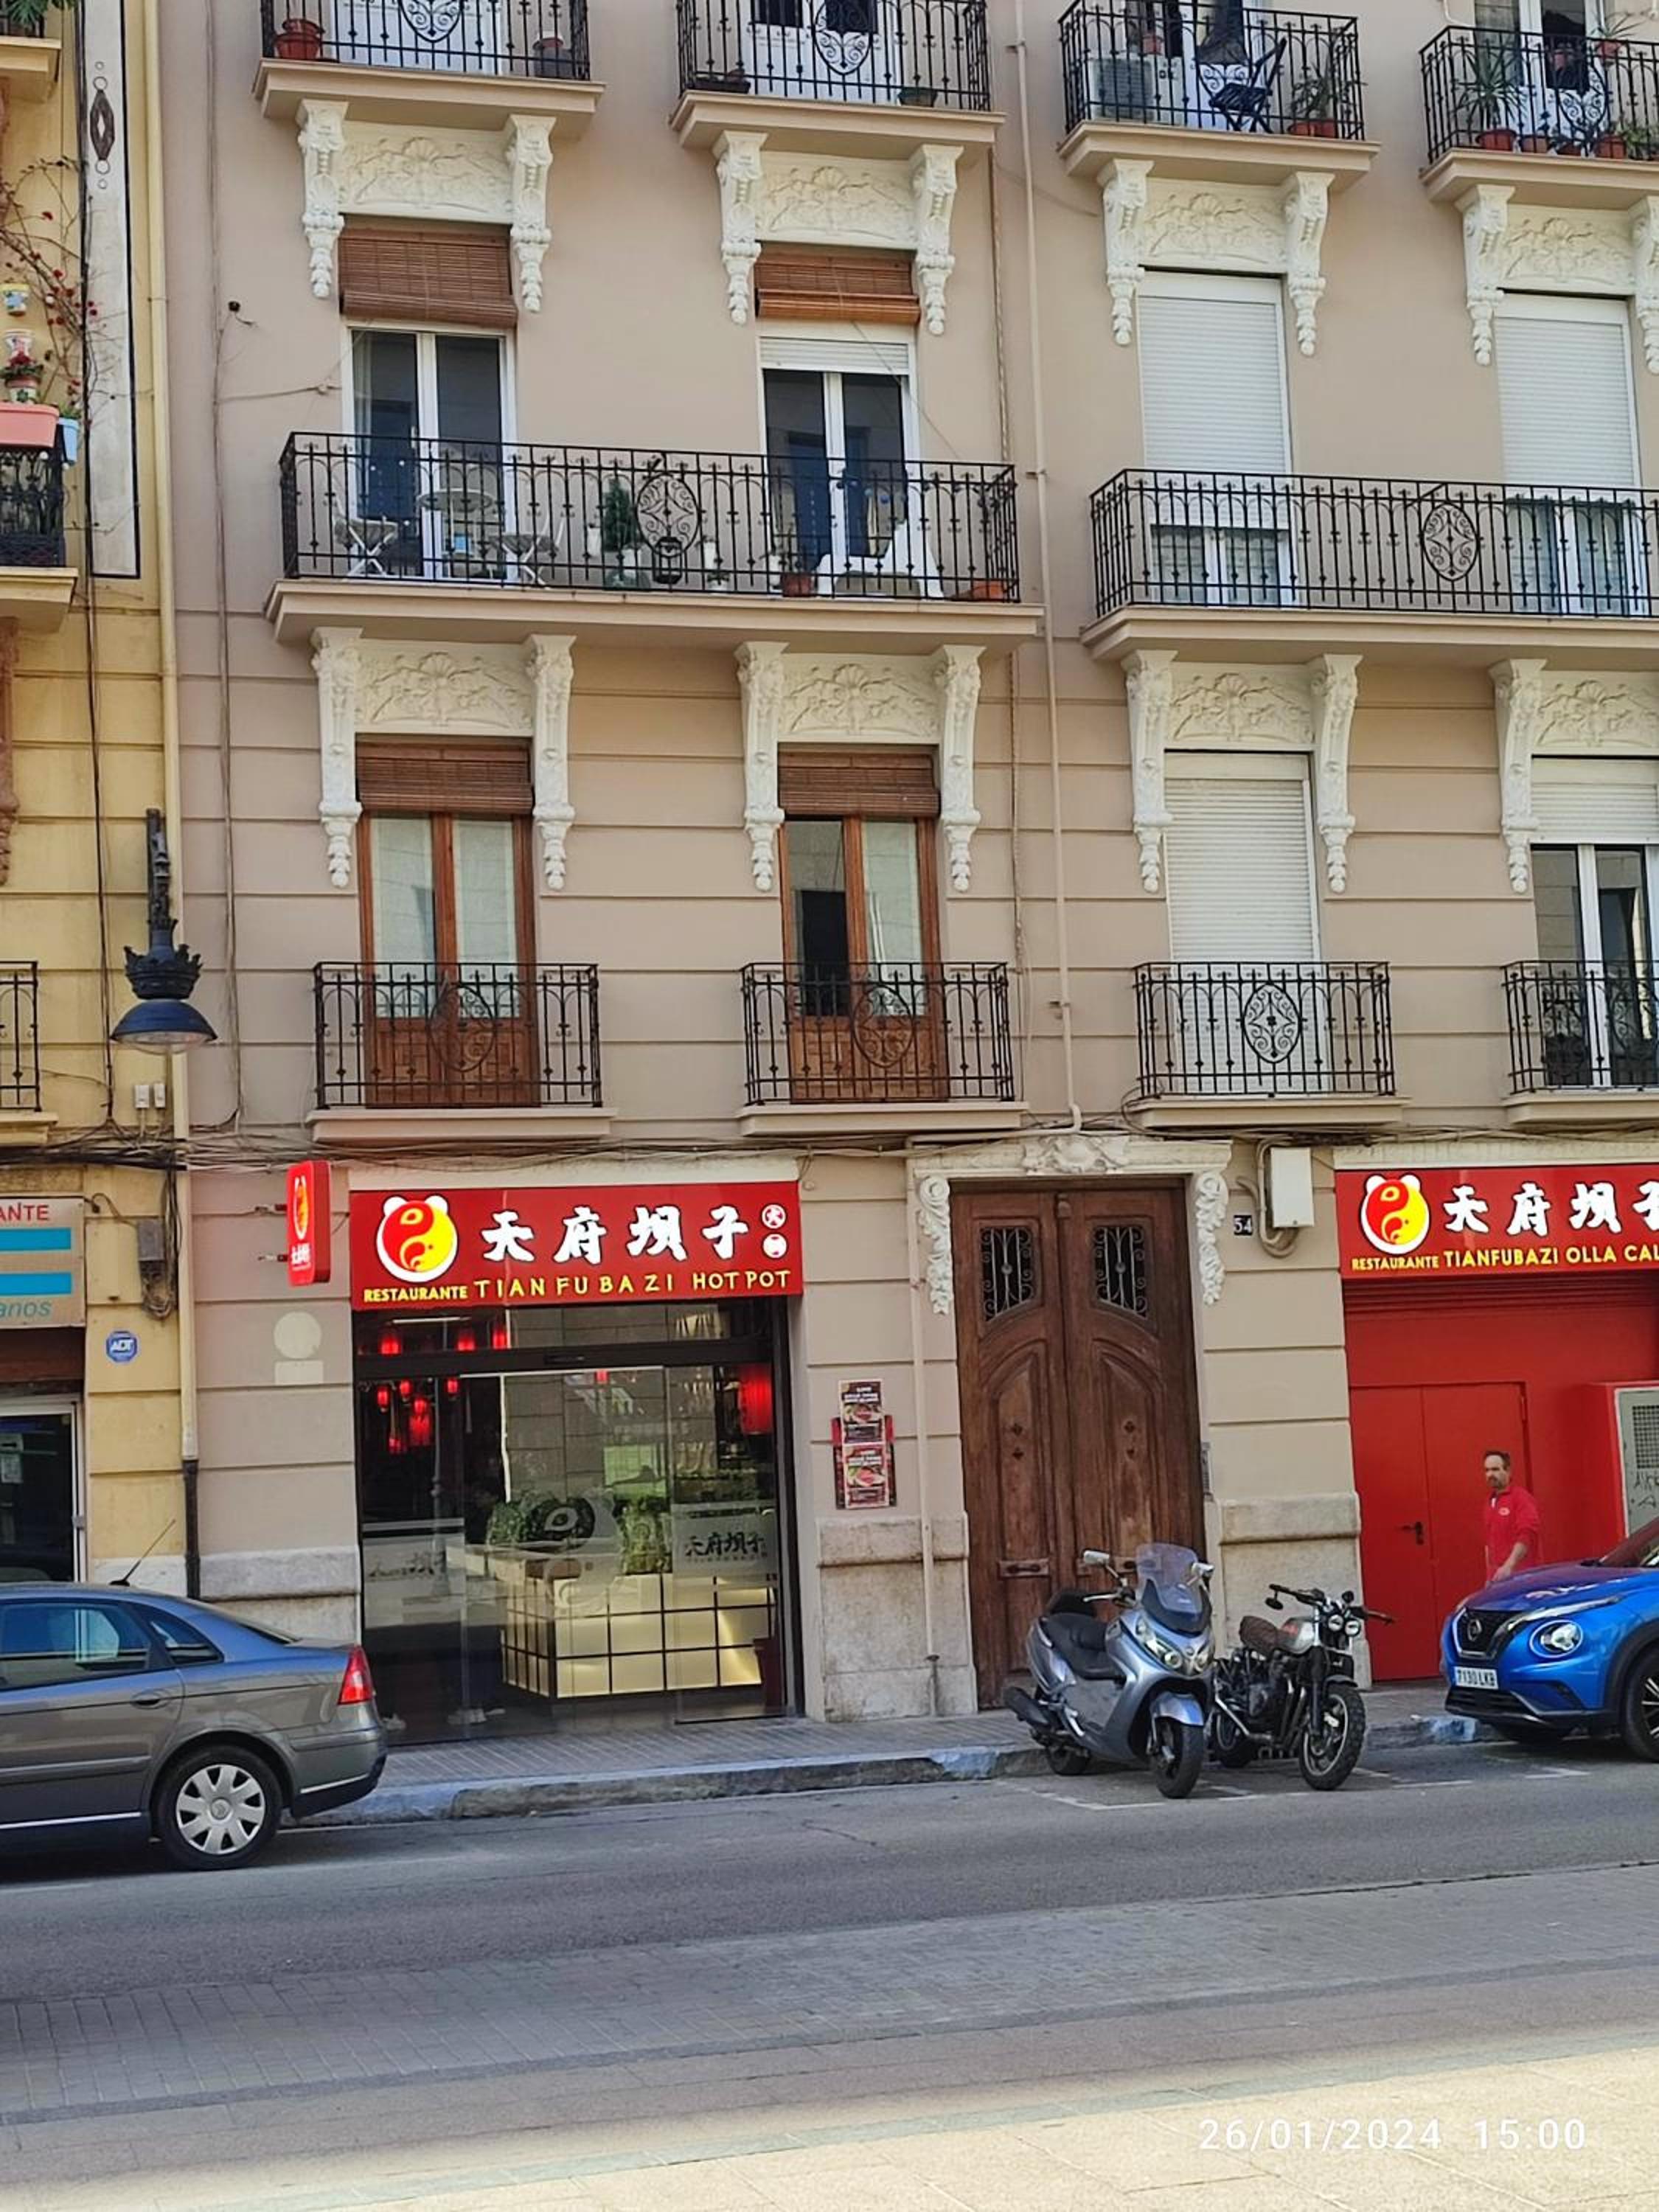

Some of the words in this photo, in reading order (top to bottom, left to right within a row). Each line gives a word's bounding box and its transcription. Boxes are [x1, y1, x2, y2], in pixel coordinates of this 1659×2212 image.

[1234, 1217, 1251, 1234] 54
[1352, 1256, 1440, 1270] RESTAURANTE
[1444, 1248, 1558, 1267] TIANFUBAZI
[1565, 1245, 1617, 1263] OLLA
[364, 1285, 469, 1303] RESTAURANTE
[473, 1278, 545, 1298] TIAN
[557, 1276, 588, 1295] FU
[599, 1275, 634, 1293] BA
[644, 1273, 673, 1292] ZI
[692, 1272, 740, 1290] HOT
[745, 1270, 791, 1289] POT
